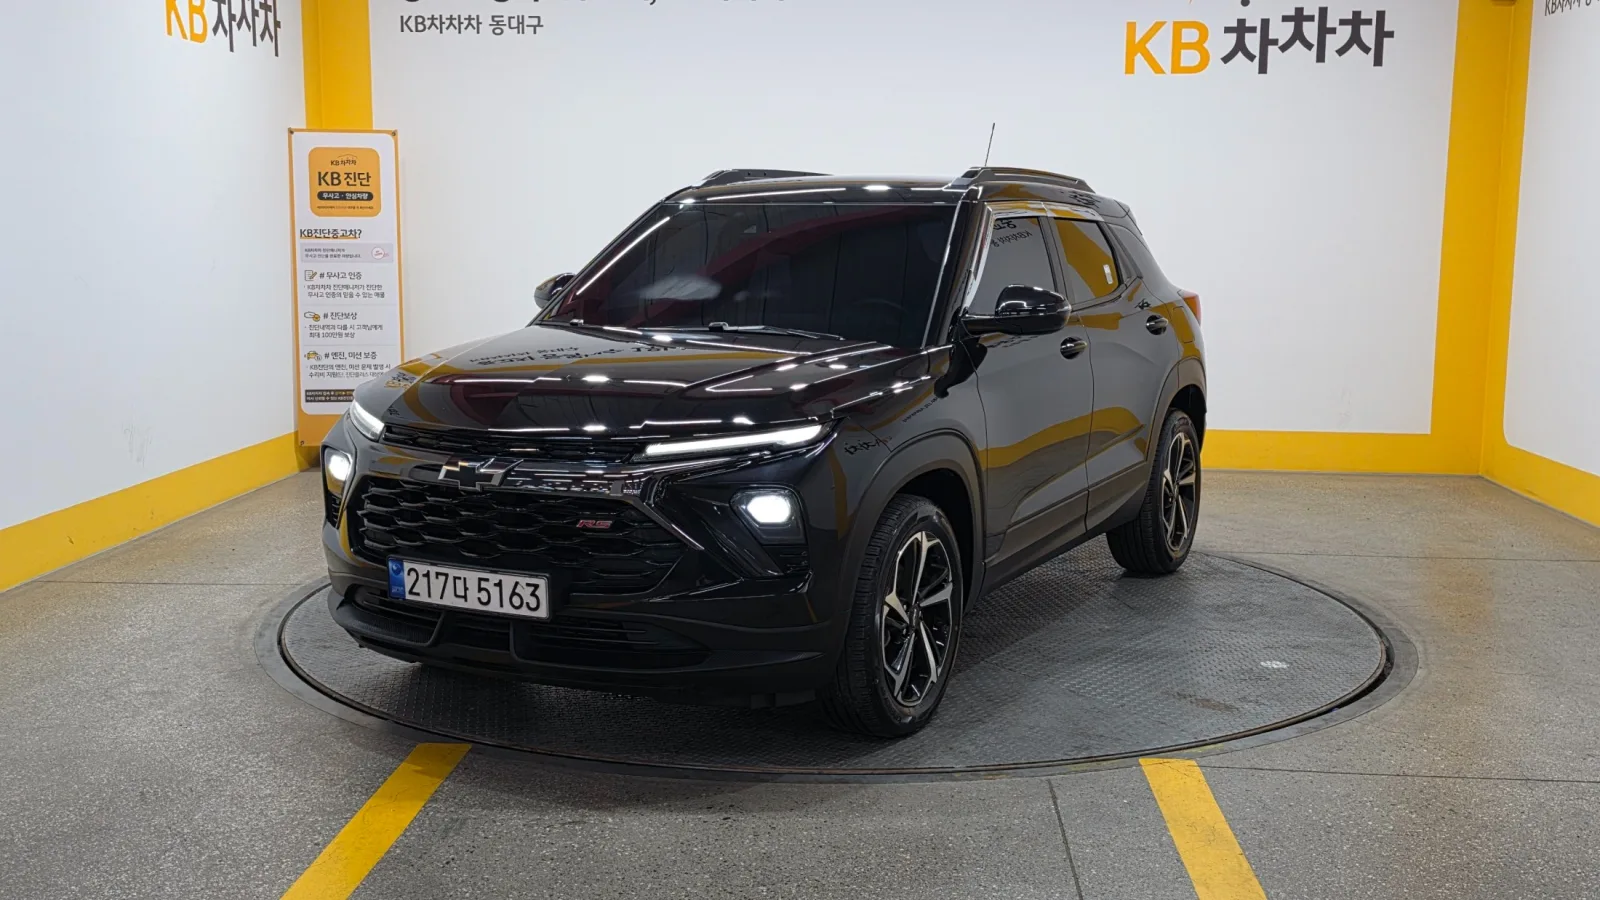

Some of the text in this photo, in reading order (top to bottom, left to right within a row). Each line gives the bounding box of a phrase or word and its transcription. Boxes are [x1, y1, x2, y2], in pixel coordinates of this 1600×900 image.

[399, 14, 544, 36] KB차차차 동대구
[1124, 5, 1395, 75] KB 차차차
[317, 171, 371, 187] KB 진단
[322, 192, 369, 200] 무사고 안심차량
[299, 228, 362, 239] KB진단중고차?
[326, 271, 347, 280] 무사고
[348, 271, 362, 280] 인증
[308, 291, 325, 299] 무사고
[330, 312, 357, 320] 진단보상
[321, 331, 343, 339] 100만원
[331, 351, 347, 360] 엔진,
[348, 351, 362, 360] 미션
[363, 351, 378, 360] 보증
[576, 519, 613, 529] RS
[406, 567, 541, 612] 217다 5163
